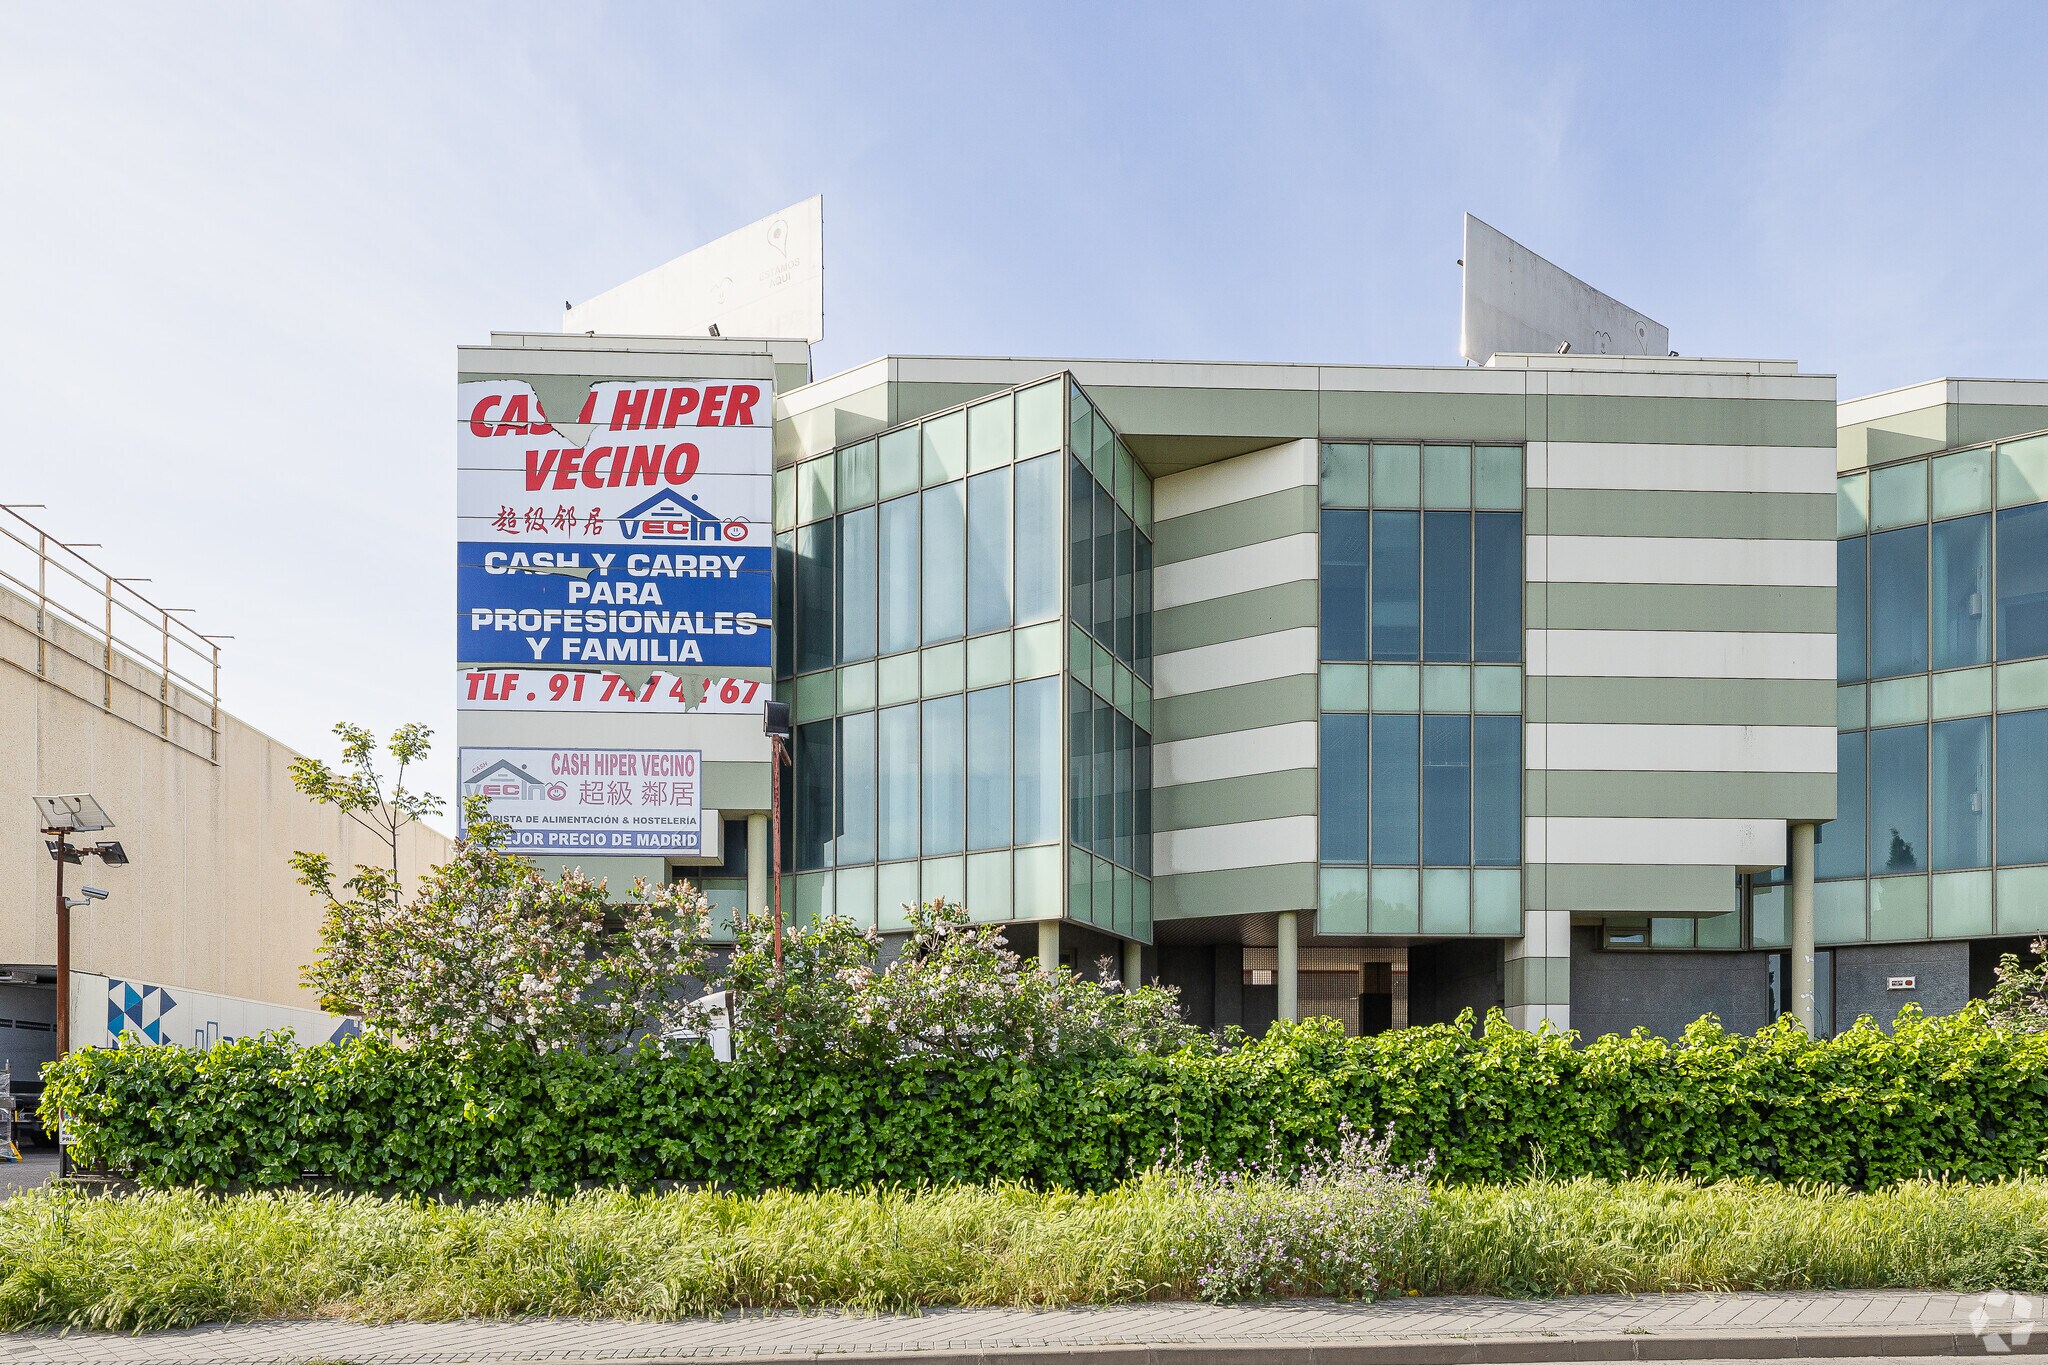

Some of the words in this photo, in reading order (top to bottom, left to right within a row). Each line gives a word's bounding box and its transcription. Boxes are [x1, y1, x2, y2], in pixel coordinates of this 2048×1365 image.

[608, 384, 760, 431] HIPER
[525, 442, 700, 491] VECINO
[592, 553, 616, 576] Y
[627, 553, 746, 578] CARRY
[568, 581, 663, 605] PARA
[471, 608, 758, 635] PROFESIONALES
[526, 637, 550, 660] Y
[562, 638, 703, 663] FAMILIA
[548, 673, 586, 702] 91
[720, 677, 760, 704] 67
[471, 761, 488, 774] CASH
[551, 752, 590, 775] CASH
[594, 753, 637, 776] HIPER
[641, 754, 695, 777] VECINO
[525, 815, 539, 823] DE
[542, 814, 619, 824] ALIMENTACIÓN
[622, 816, 630, 824] &
[633, 815, 697, 825] HOSTELERÍA
[490, 832, 544, 846] EJOR
[548, 832, 607, 846] PRECIO
[611, 833, 632, 846] DE
[636, 833, 698, 847] MADRID
